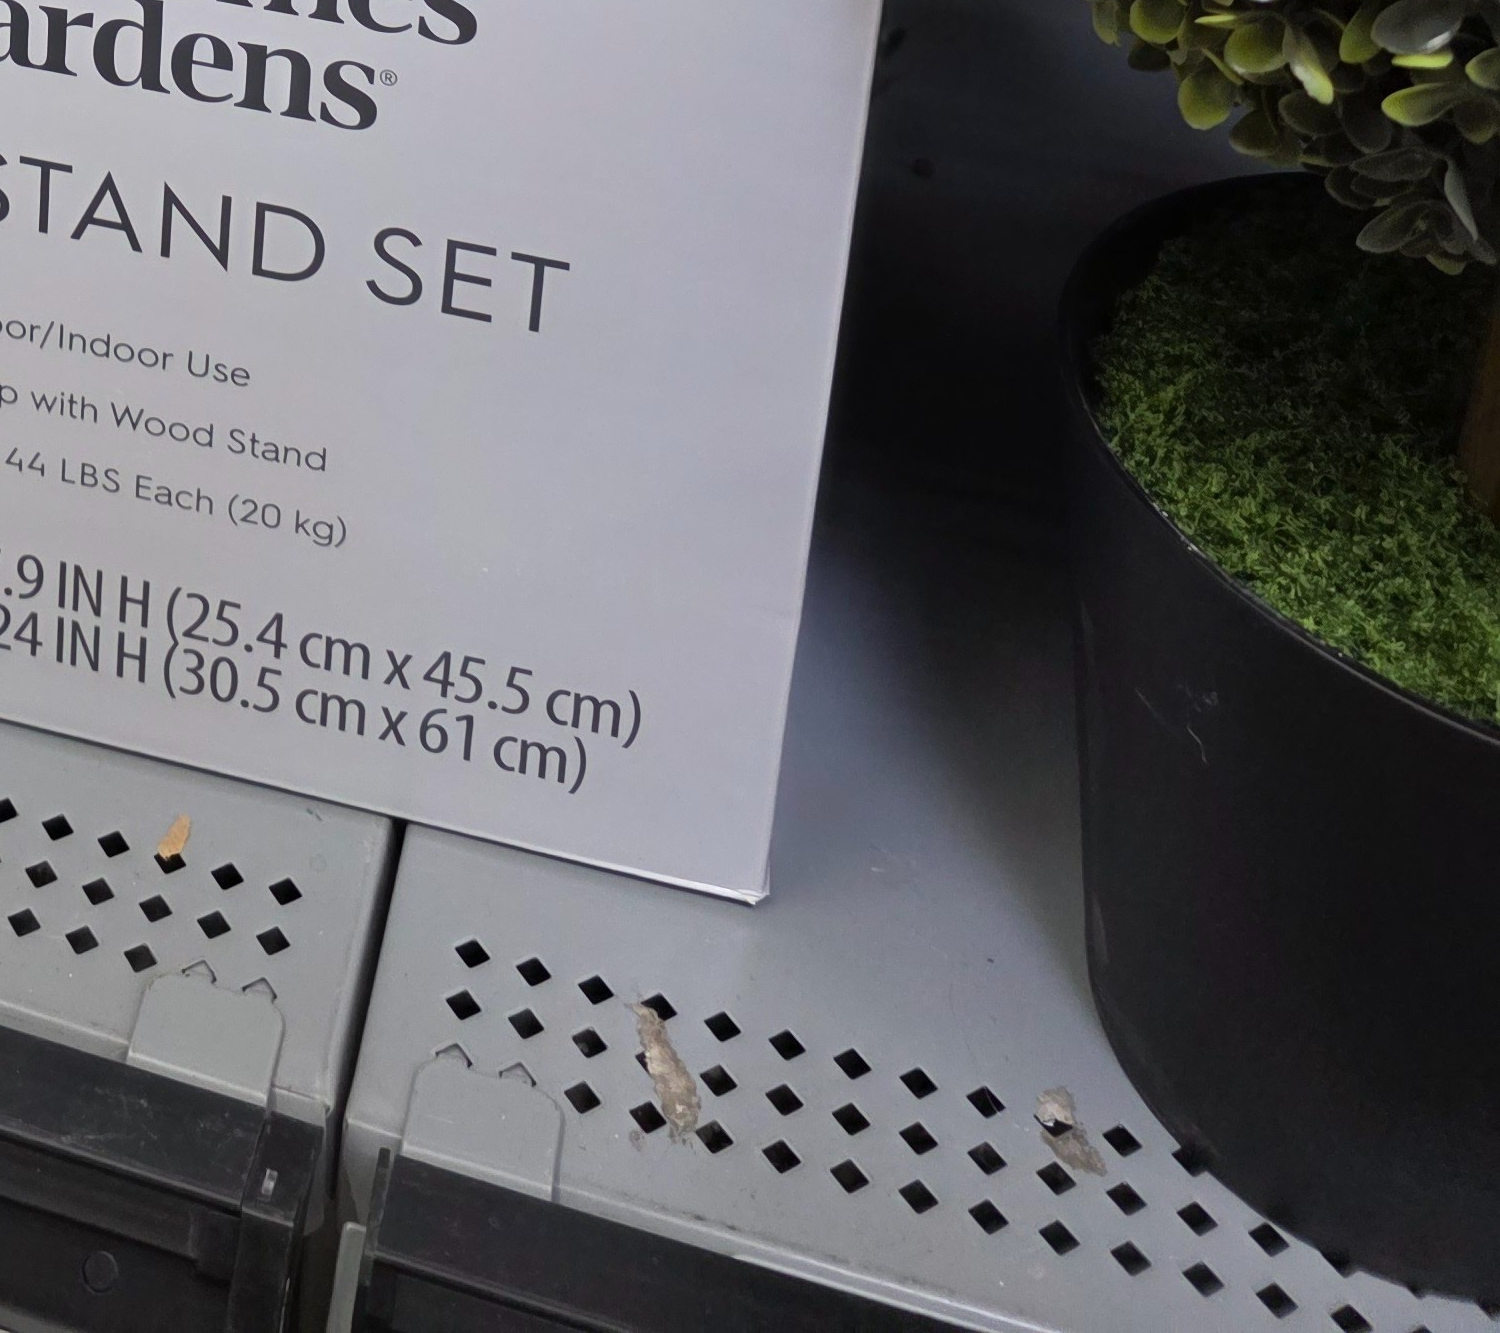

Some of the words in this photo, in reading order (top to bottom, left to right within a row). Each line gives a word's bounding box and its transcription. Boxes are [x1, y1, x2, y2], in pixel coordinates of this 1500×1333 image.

[365, 227, 570, 333] SET
[187, 350, 252, 388] Use
[31, 391, 100, 425] with
[110, 401, 215, 450] Wood
[227, 429, 329, 473] Stand
[4, 447, 47, 479] 44
[60, 458, 122, 495] LBS
[134, 475, 215, 516] Each
[227, 494, 282, 531] (20
[295, 510, 348, 549] kg)
[55, 616, 102, 673] IN
[116, 631, 148, 684] H
[163, 643, 283, 714] (30.5
[294, 687, 366, 737] cm
[379, 704, 407, 747] x
[419, 708, 475, 763] 61
[492, 735, 588, 795] cm)
[57, 560, 103, 618] IN
[118, 574, 151, 628] H
[165, 586, 288, 659] (25.4
[299, 631, 372, 681] cm
[384, 648, 412, 691] x
[422, 649, 534, 716] 45.5
[545, 685, 643, 749] cm)
